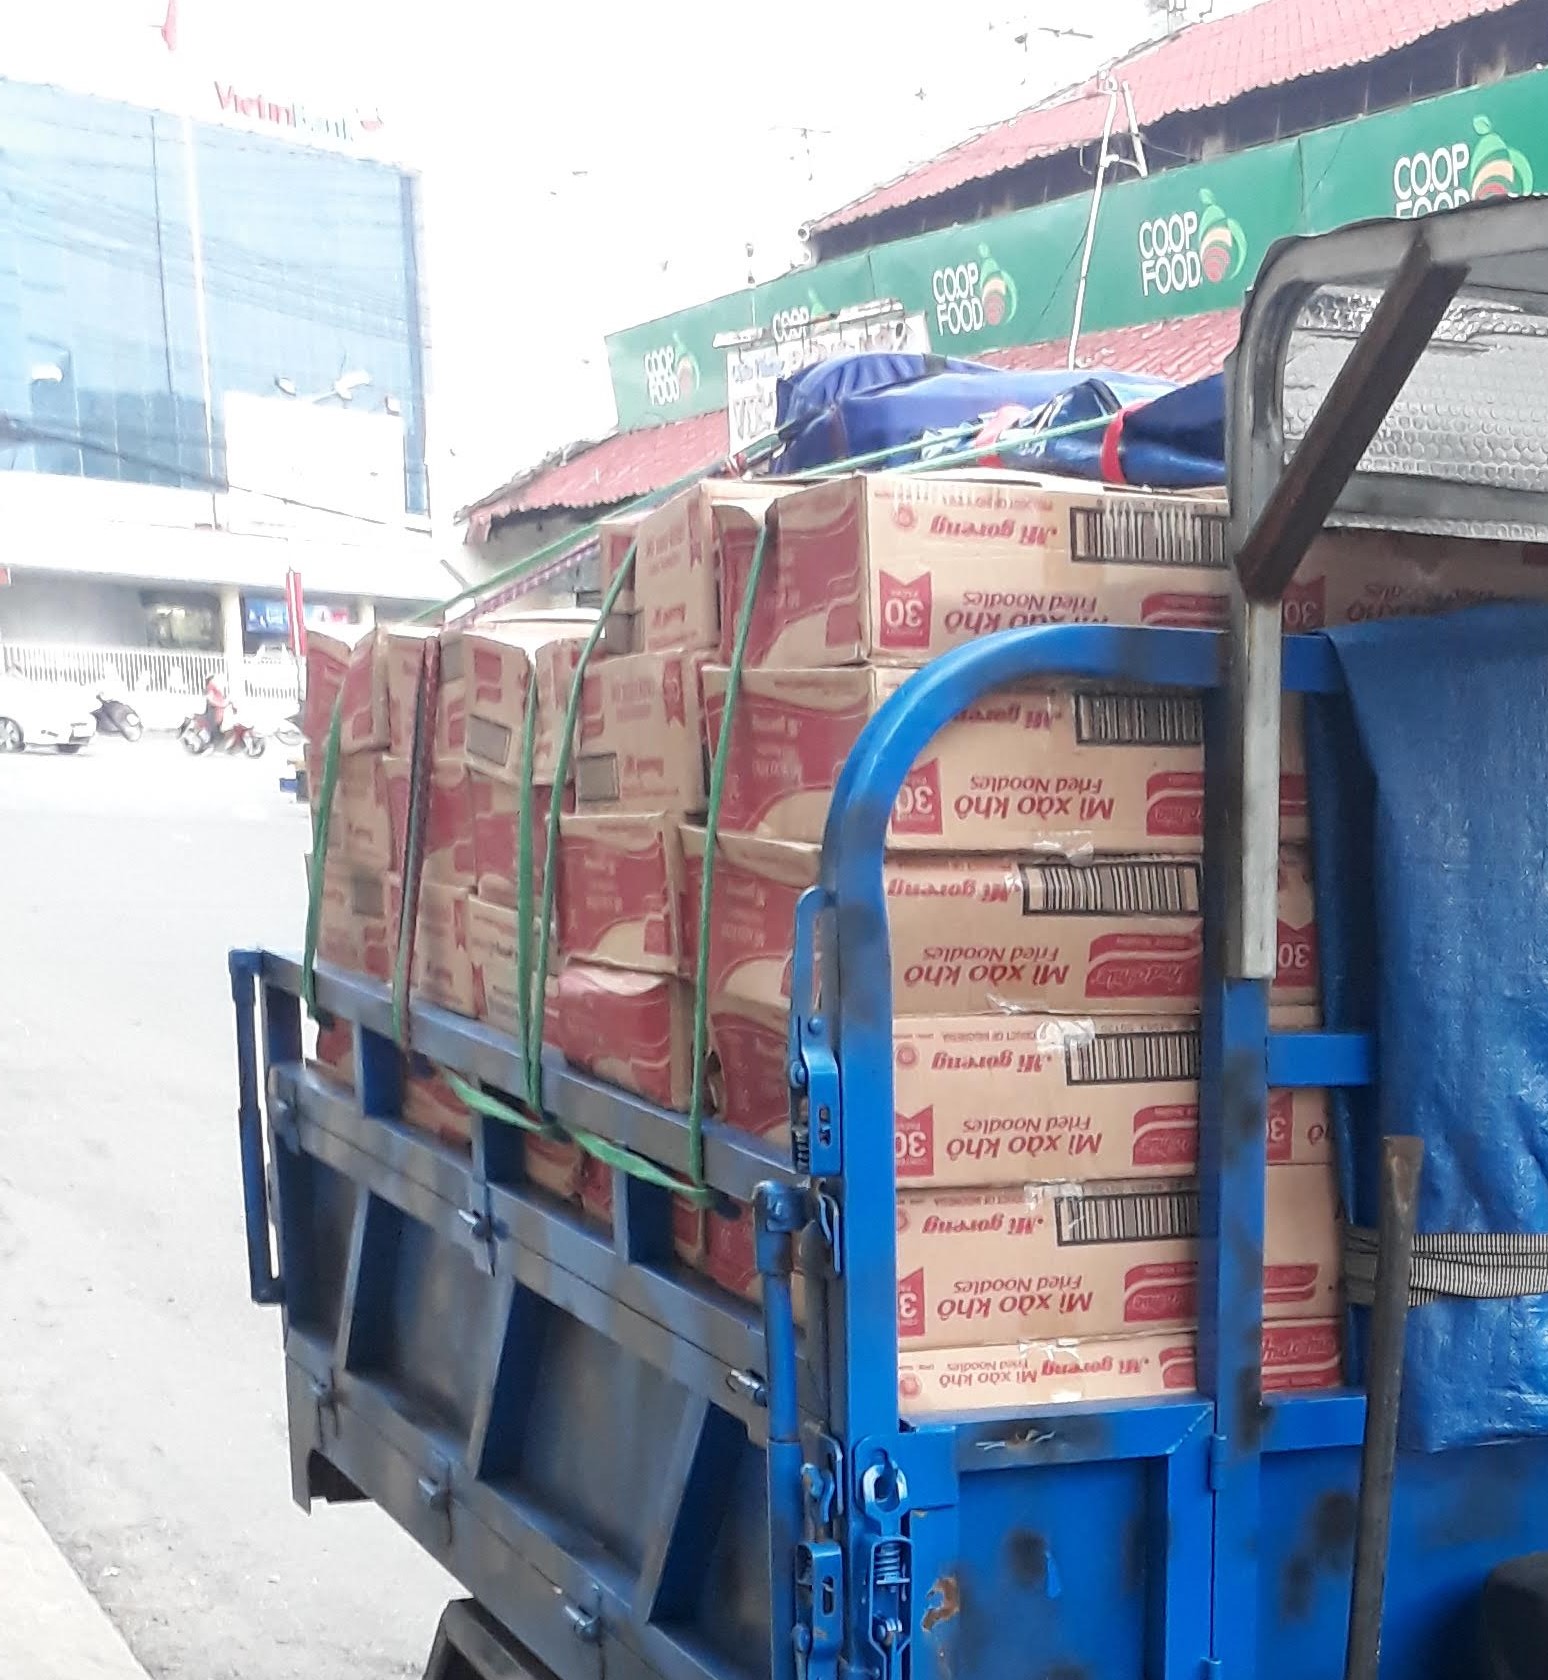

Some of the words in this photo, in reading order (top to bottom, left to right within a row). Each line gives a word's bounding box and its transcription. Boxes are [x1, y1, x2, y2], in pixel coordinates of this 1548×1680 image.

[1142, 251, 1200, 296] FOOD
[936, 297, 984, 336] FOOD
[928, 515, 1015, 545] goreng
[883, 597, 925, 629] 30
[961, 590, 1046, 612] Noodles
[1049, 595, 1098, 614] Fried
[970, 775, 1052, 795] Noodles
[1055, 777, 1104, 795] Fried
[953, 795, 1011, 821] khô
[1016, 796, 1073, 820] xào
[1079, 796, 1115, 821] Mì
[922, 945, 1007, 964] Noodles
[1010, 946, 1060, 963] Fried
[1278, 942, 1311, 970] 30
[903, 964, 962, 988] khô
[968, 963, 1026, 987] xào
[1033, 964, 1070, 986] Mì
[931, 1049, 1014, 1074] goreng
[962, 1116, 1043, 1136] Noodles
[1046, 1115, 1093, 1134] Fried
[1269, 1116, 1287, 1142] 3
[945, 1137, 1002, 1162] khô
[1007, 1134, 1063, 1158] xào
[1067, 1132, 1103, 1156] Mì
[921, 1213, 1005, 1238] goreng
[952, 1277, 1034, 1296] Noodles
[1037, 1274, 1083, 1294] Fried
[898, 1291, 918, 1318] 3
[936, 1297, 992, 1322] khô
[998, 1293, 1054, 1317] xào
[1058, 1291, 1094, 1313] Mì
[938, 1372, 974, 1390] khô
